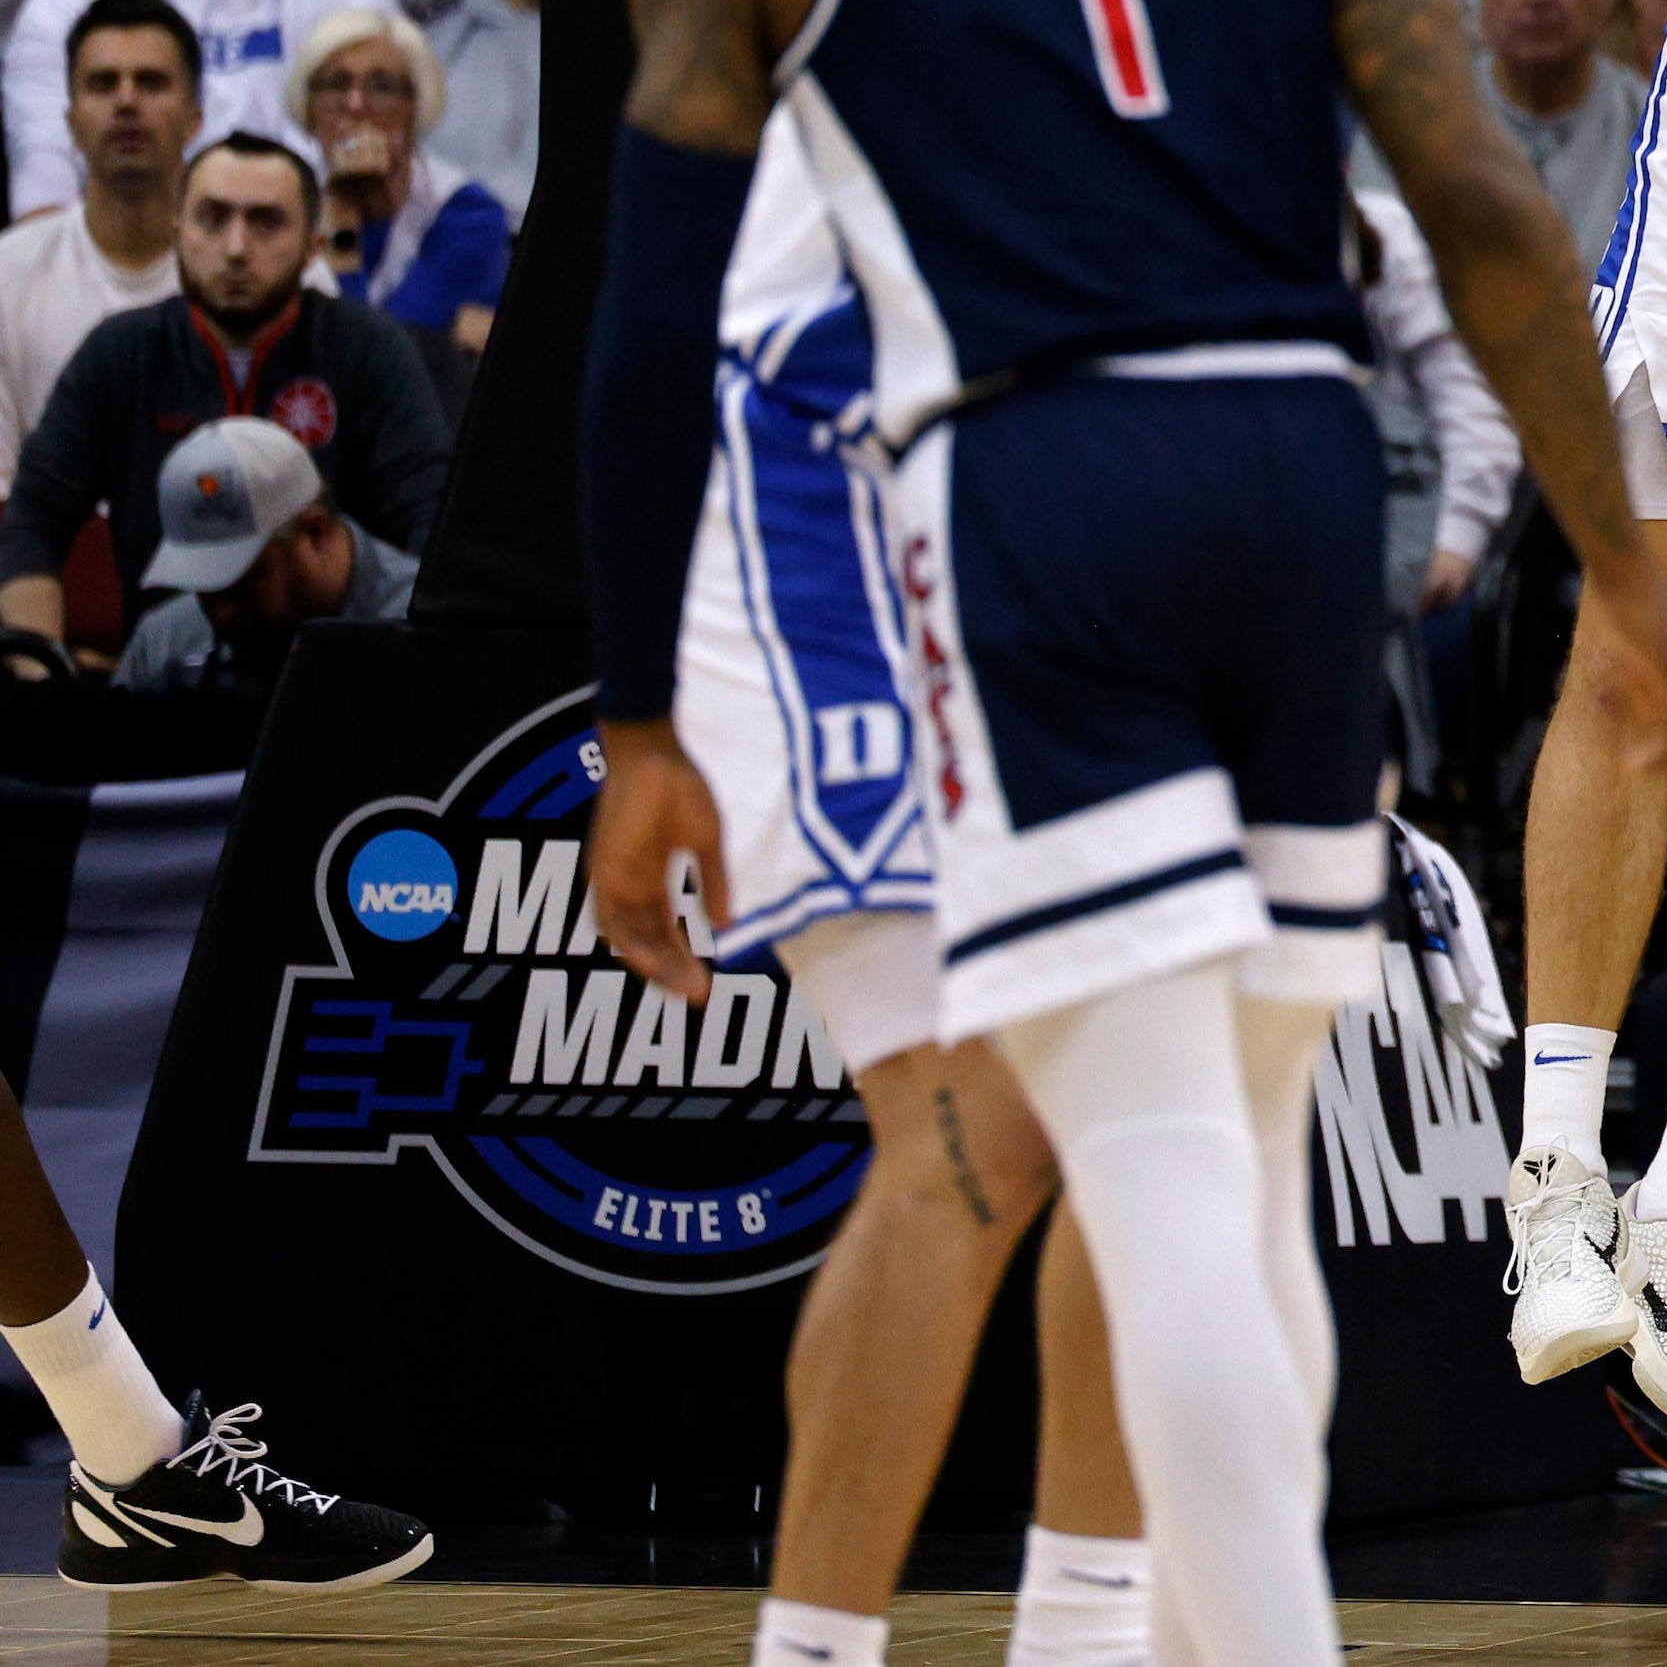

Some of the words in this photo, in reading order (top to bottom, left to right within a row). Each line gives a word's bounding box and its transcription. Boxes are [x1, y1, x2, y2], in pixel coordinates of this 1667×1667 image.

[814, 702, 904, 785] D
[358, 881, 454, 914] NCAA
[510, 969, 846, 1091] MADN
[1313, 940, 1513, 1247] NCAA
[594, 1186, 722, 1244] ELITE
[737, 1192, 767, 1235] 8
